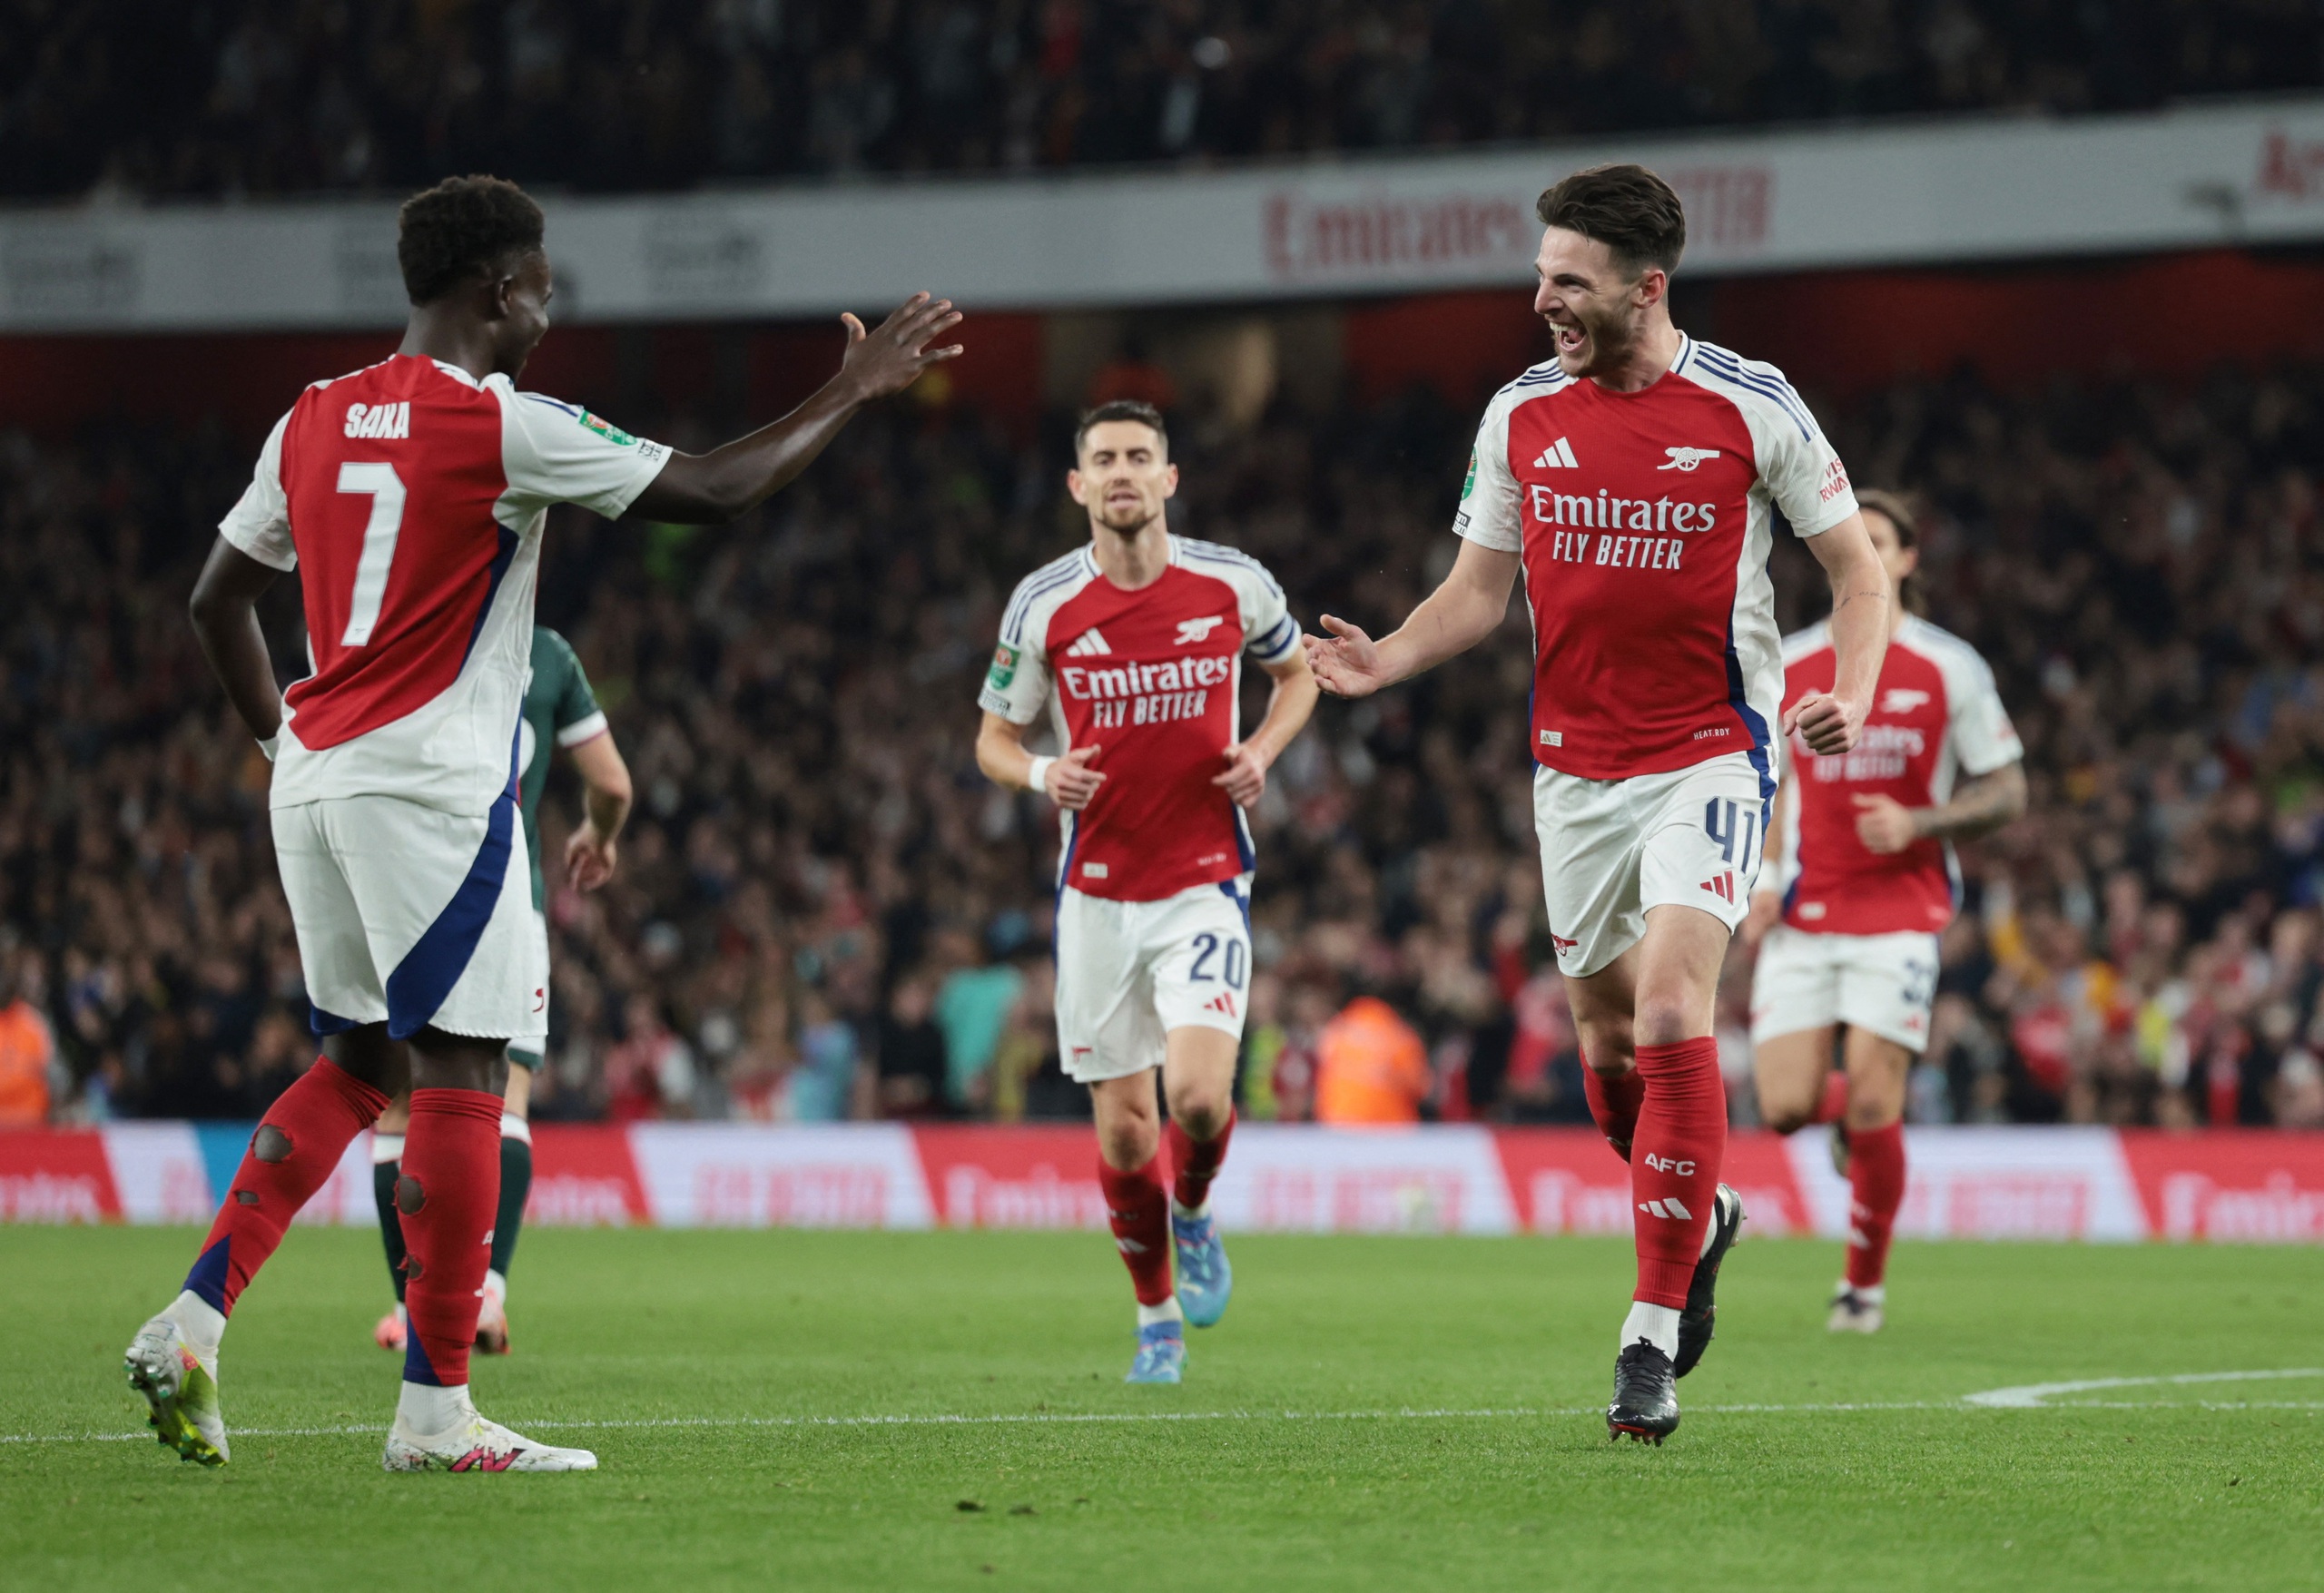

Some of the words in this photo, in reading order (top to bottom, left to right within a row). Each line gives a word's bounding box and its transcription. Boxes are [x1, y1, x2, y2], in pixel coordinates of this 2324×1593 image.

[343, 401, 410, 438] SAKA
[1825, 457, 1844, 479] VIS
[1531, 484, 1716, 533] Emirates
[1819, 476, 1849, 503] RWA
[337, 462, 407, 646] 7
[1552, 531, 1590, 563] FLY
[1595, 535, 1684, 570] BETTER
[1061, 655, 1229, 700] Emirates
[1093, 700, 1128, 729] FLY
[1134, 690, 1207, 725] BETTER
[1693, 728, 1730, 741] HEAT.RDY
[1703, 796, 1756, 877] 41
[1189, 933, 1244, 991] 20
[1645, 1153, 1695, 1176] AFC
